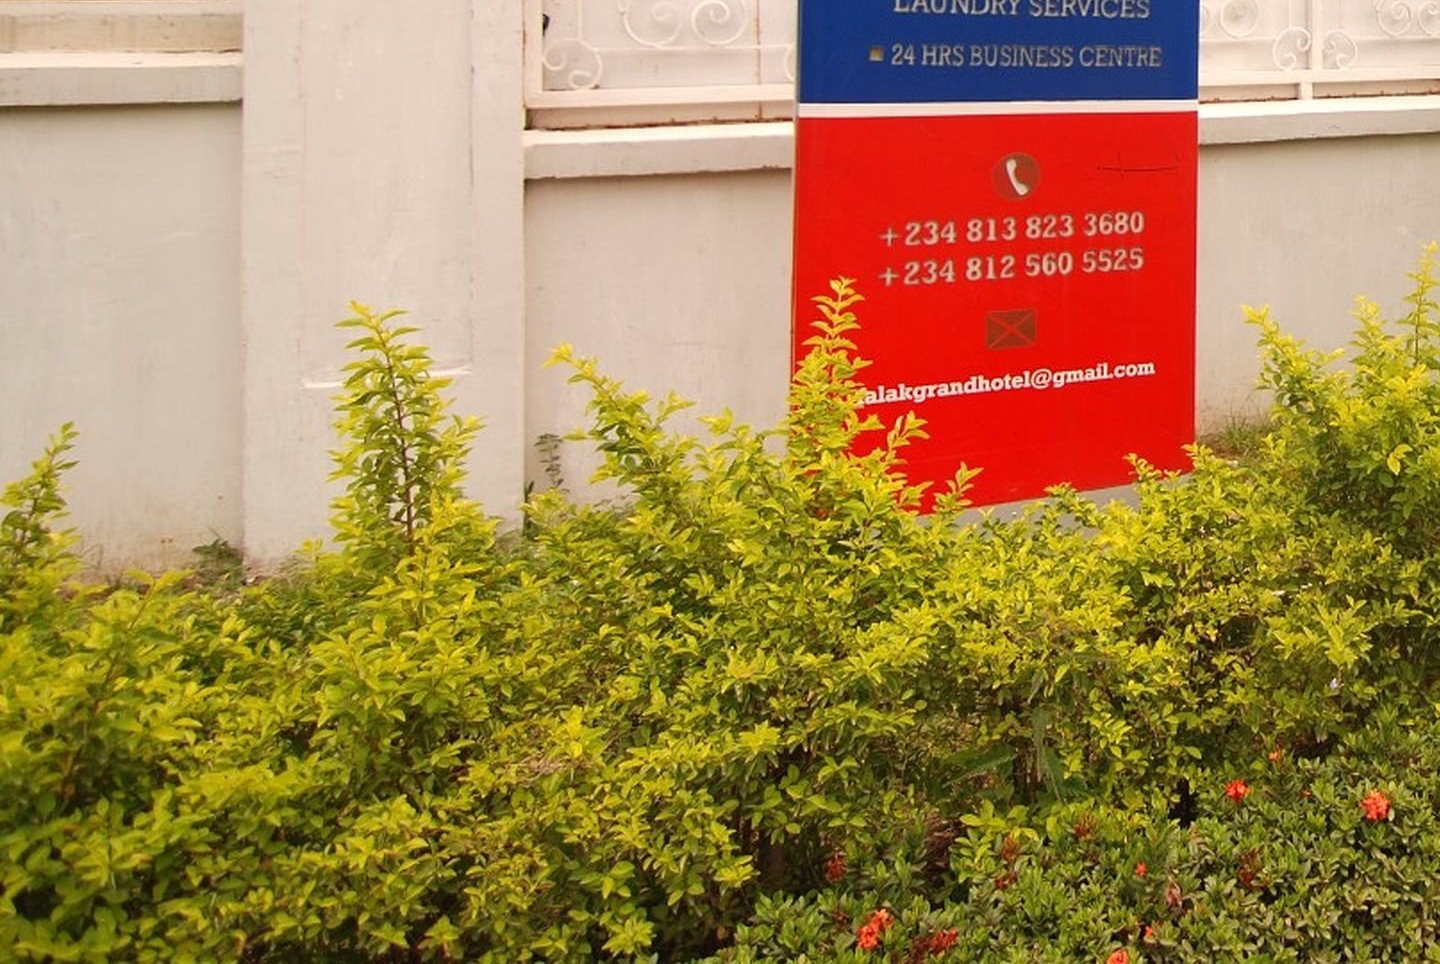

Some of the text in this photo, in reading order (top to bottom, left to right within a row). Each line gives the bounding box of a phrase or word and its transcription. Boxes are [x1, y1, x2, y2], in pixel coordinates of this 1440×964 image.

[891, 43, 1162, 68] 24 HRS BUSINESS CENTRE
[966, 218, 1017, 243] 813
[1025, 214, 1075, 240] 823
[1084, 211, 1145, 237] 3680
[965, 255, 1016, 282] 812
[1025, 251, 1074, 277] 560
[1082, 248, 1144, 274] 5525
